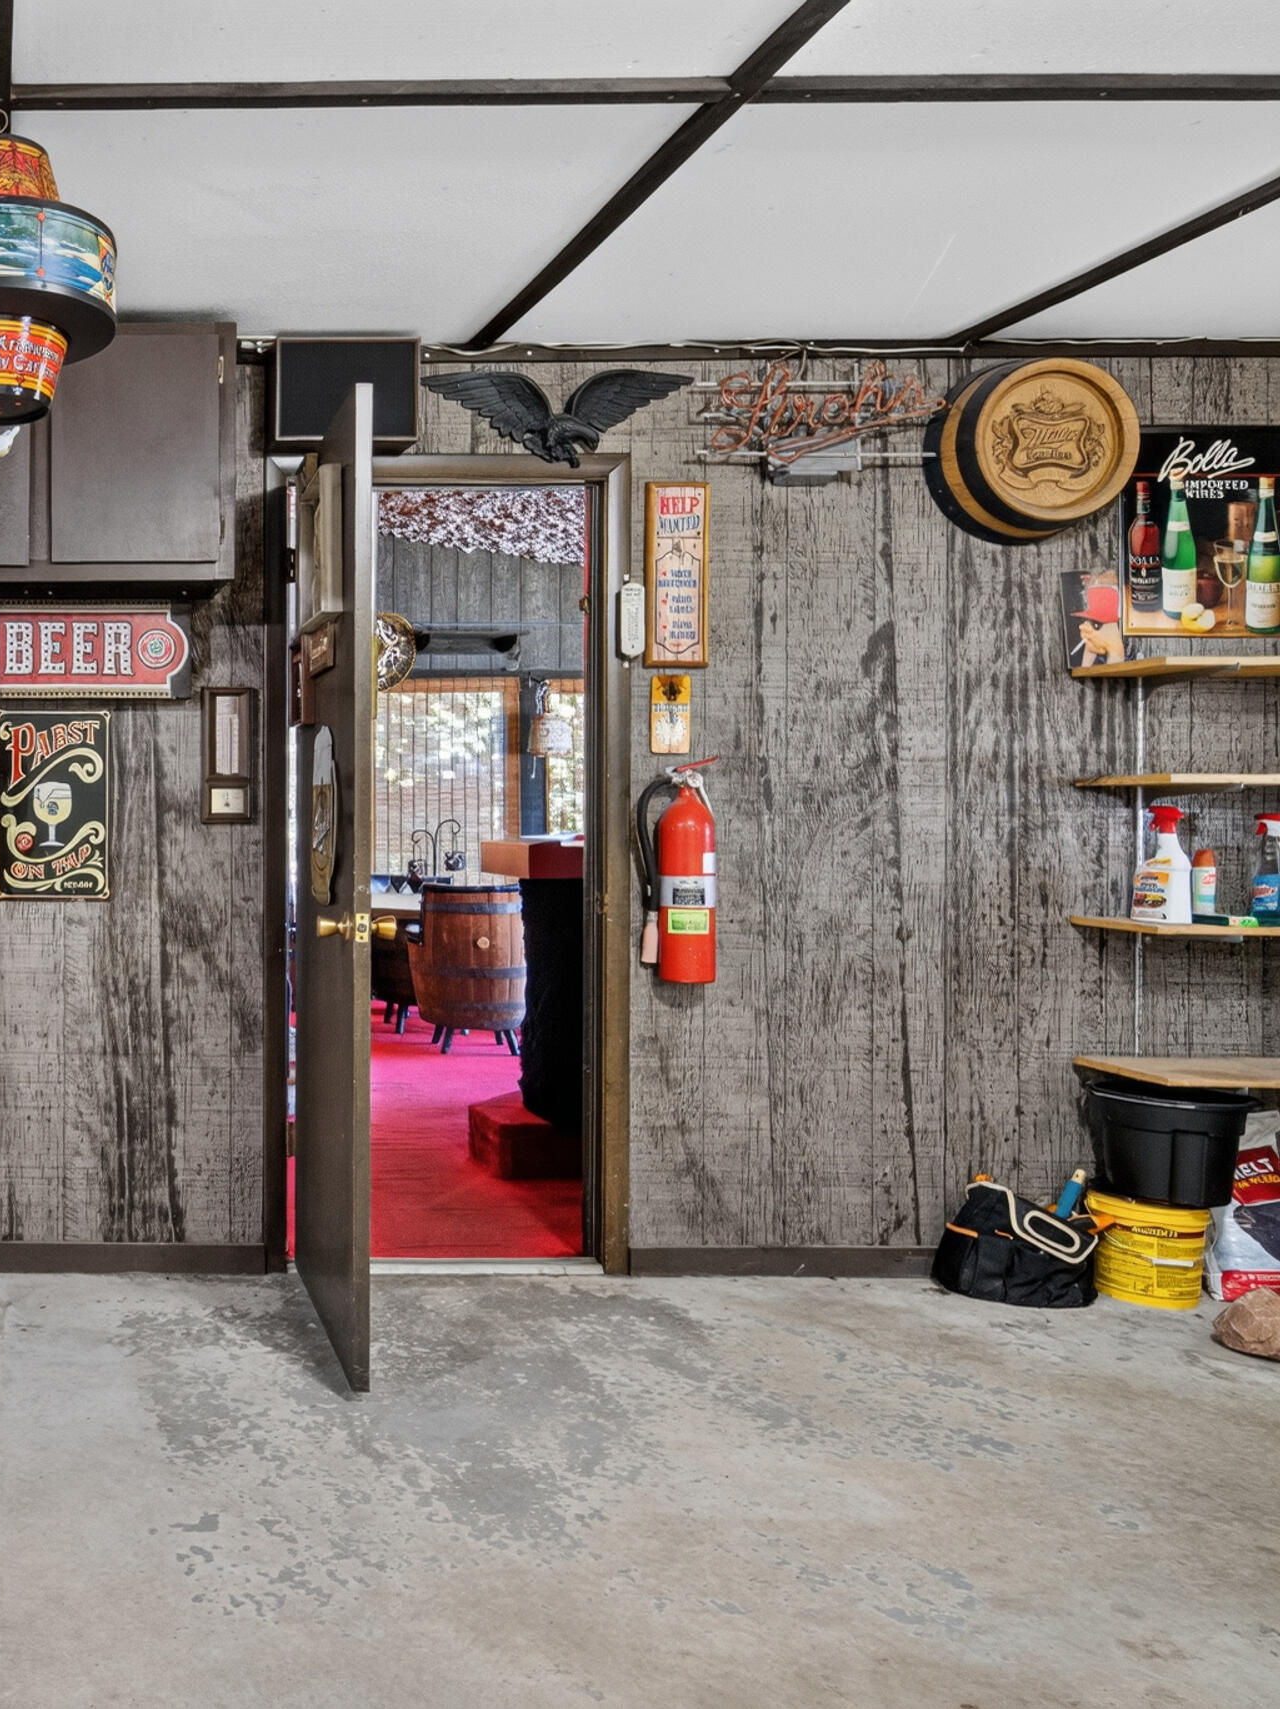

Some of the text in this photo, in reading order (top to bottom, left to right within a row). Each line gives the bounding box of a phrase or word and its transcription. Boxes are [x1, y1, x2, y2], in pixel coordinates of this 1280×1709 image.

[1157, 436, 1255, 483] Bolla
[1185, 479, 1249, 490] IMPORTED
[1185, 489, 1224, 499] WINES
[660, 496, 699, 515] HELP
[4, 621, 135, 676] BEER
[5, 720, 100, 791] PABST
[10, 843, 92, 880] ON TAP
